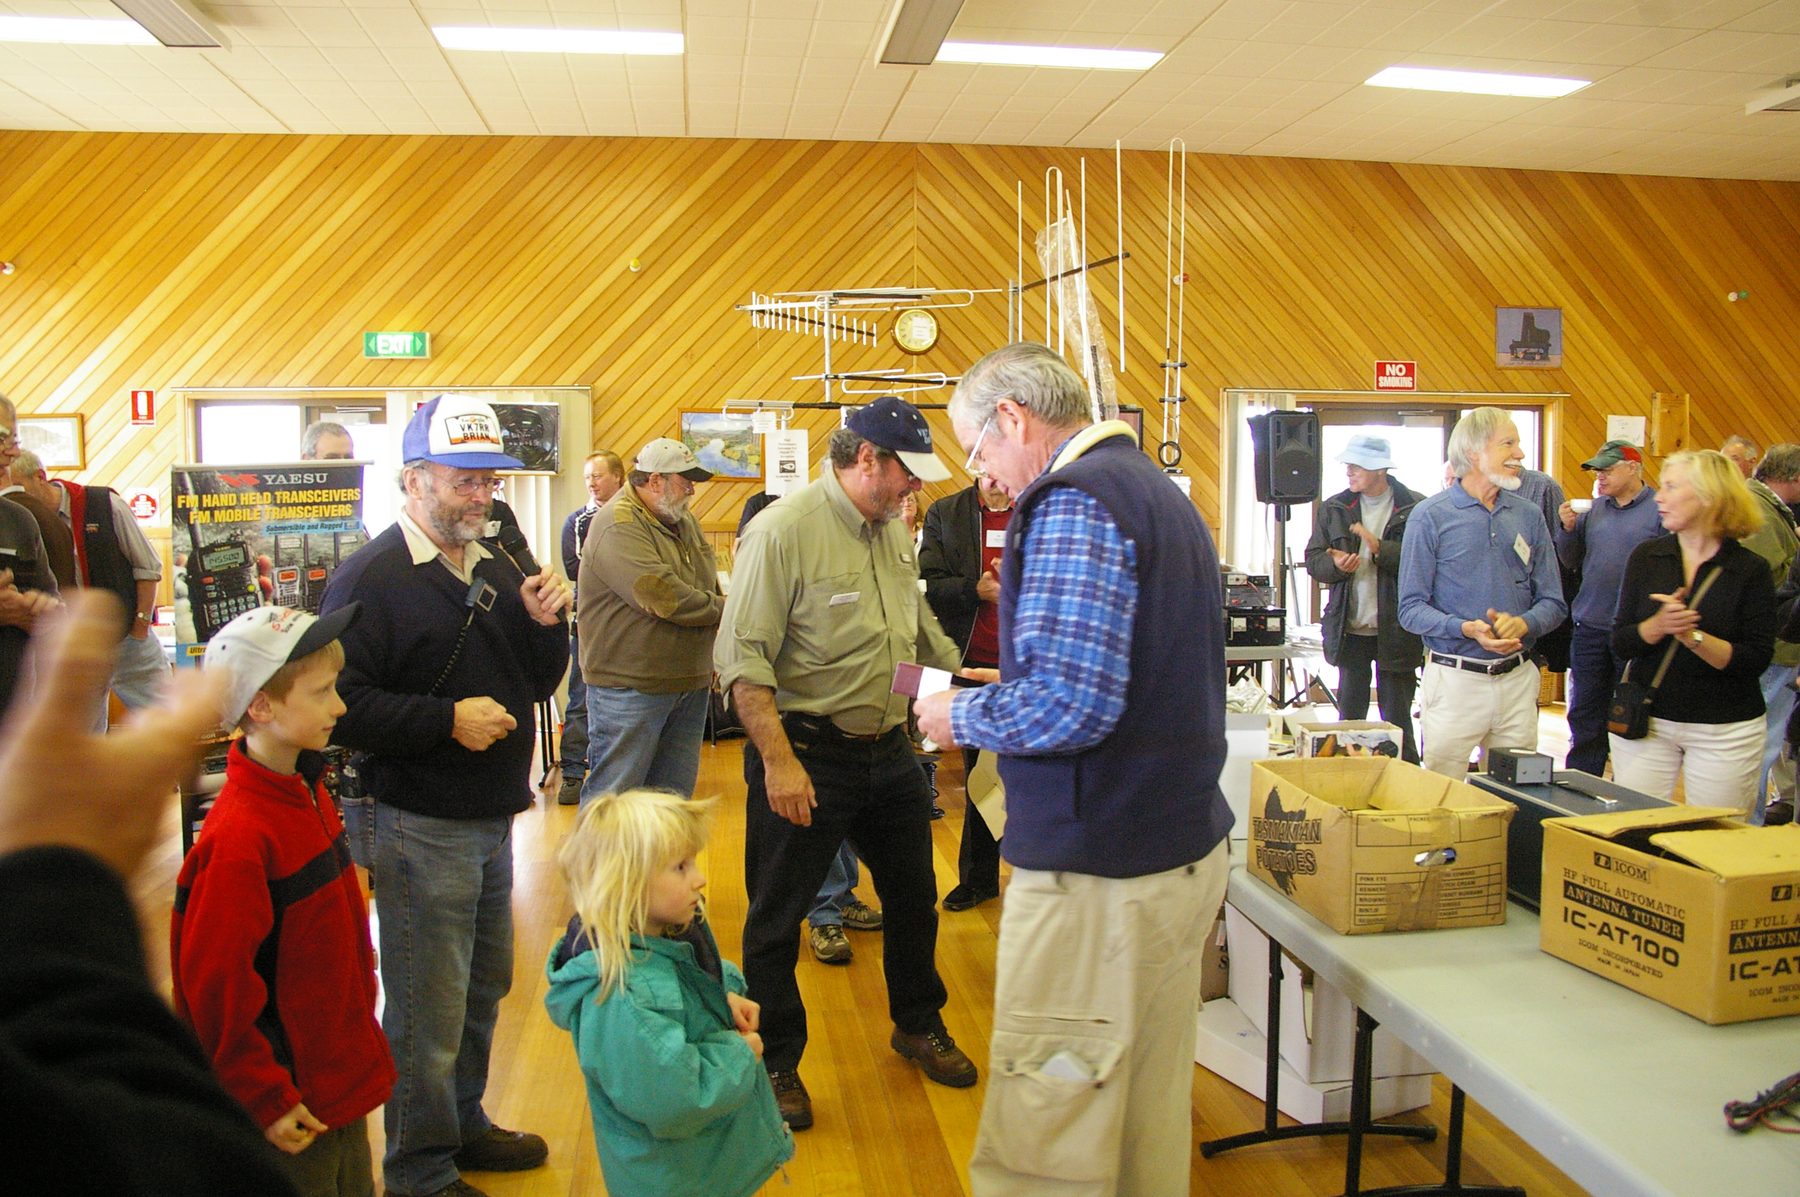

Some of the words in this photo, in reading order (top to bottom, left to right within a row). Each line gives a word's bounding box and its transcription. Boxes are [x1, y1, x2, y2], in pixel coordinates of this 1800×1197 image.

[376, 334, 414, 354] EXIT
[1385, 363, 1406, 377] NO
[1378, 376, 1413, 388] SMOKING
[463, 431, 491, 441] BRIAN
[263, 473, 329, 486] YAESU
[177, 495, 199, 509] FM
[202, 493, 237, 508] HAND
[240, 492, 271, 506] HELD
[275, 488, 361, 505] TRANSCEIVERS
[189, 510, 211, 525] FM
[214, 508, 261, 523] MOBILE
[265, 503, 353, 520] TRANSCEIVERS
[265, 523, 305, 533] Submersible
[307, 522, 319, 531] and
[320, 521, 343, 531] Rugged
[1253, 817, 1322, 844] TASMANIAN
[1256, 845, 1317, 875] POTATOES
[1615, 861, 1647, 880] ICOM
[1563, 868, 1577, 880] HF
[1582, 874, 1611, 893] FULL
[1615, 887, 1686, 919] AUTOMATIC
[1566, 885, 1629, 918] ANTENNA
[1631, 908, 1682, 936] TUNER
[1730, 919, 1748, 931] HF
[1754, 914, 1788, 929] FULL
[1563, 906, 1680, 968] IC-AT100
[1578, 938, 1599, 952] ICOM
[1603, 948, 1663, 979] INCORPORATED
